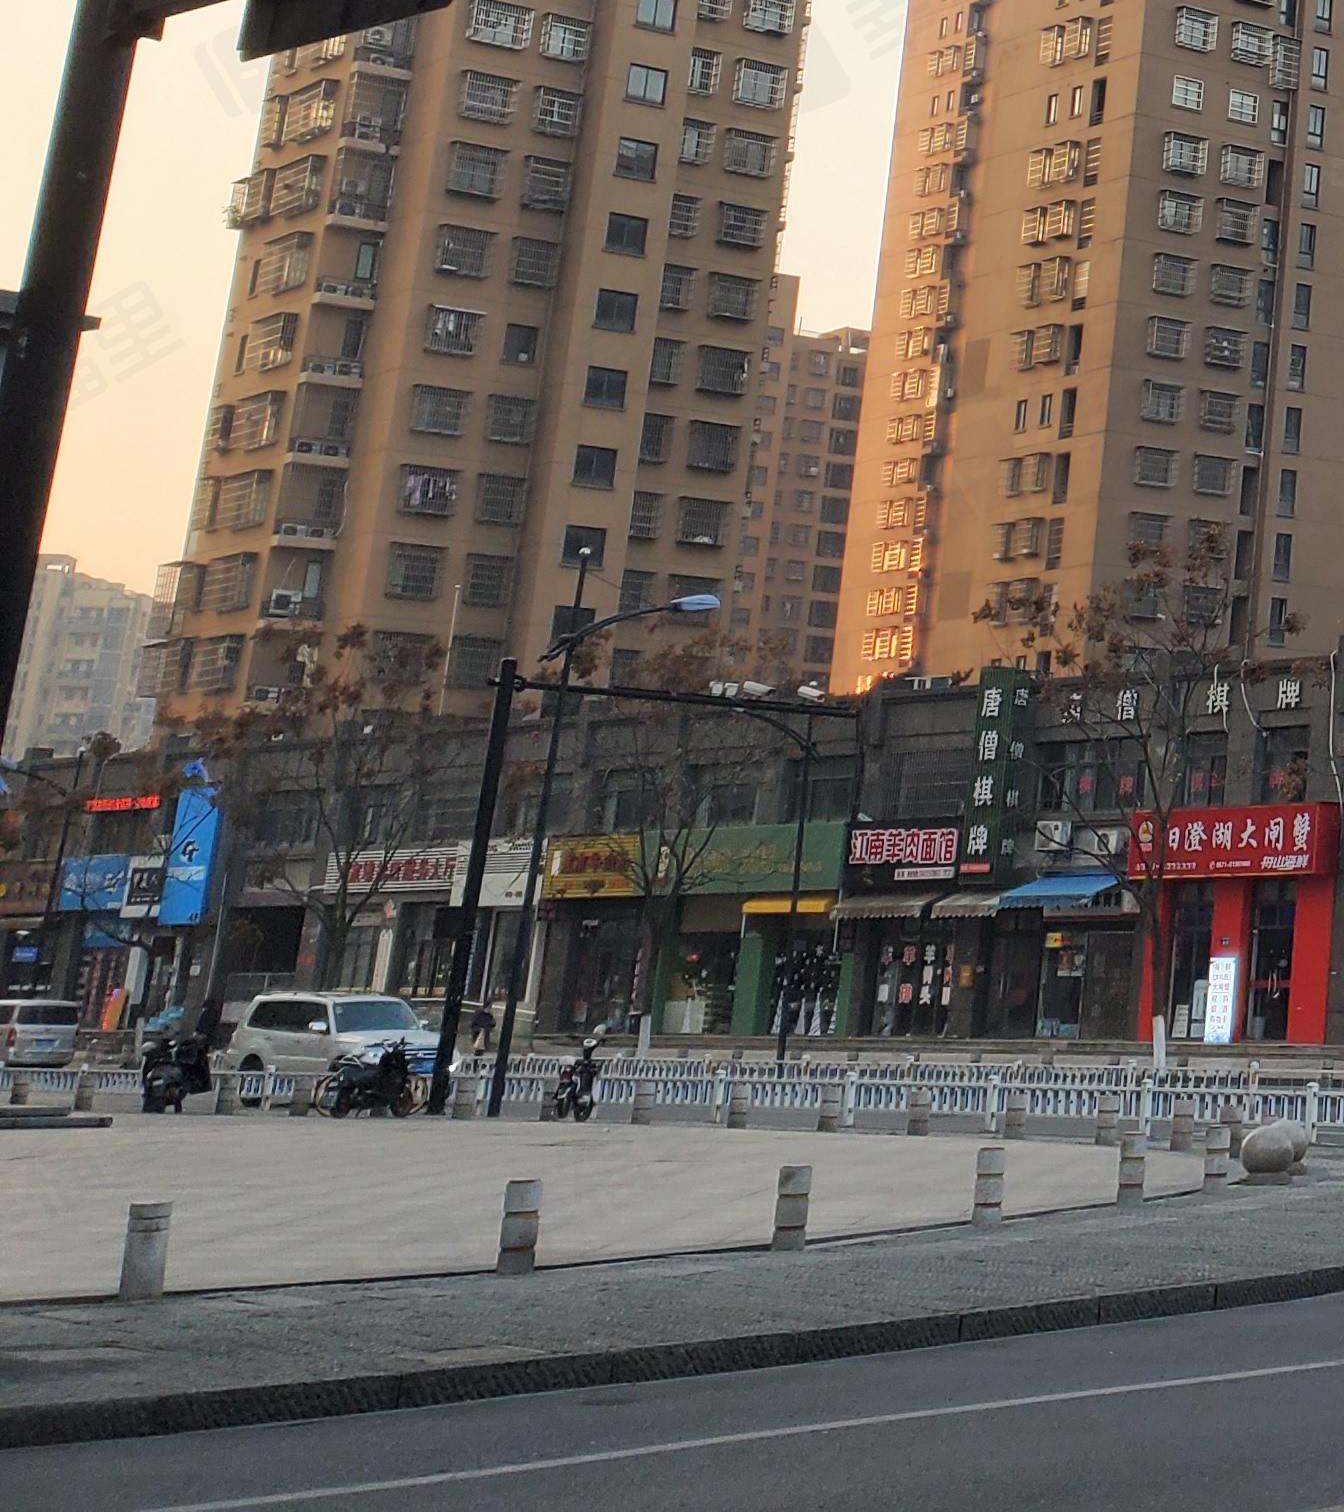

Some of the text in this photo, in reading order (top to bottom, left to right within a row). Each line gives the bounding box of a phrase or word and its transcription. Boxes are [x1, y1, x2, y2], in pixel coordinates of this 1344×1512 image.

[967, 687, 1002, 857] 唐僧棋牌
[849, 828, 958, 864] 江南羊肉面馆
